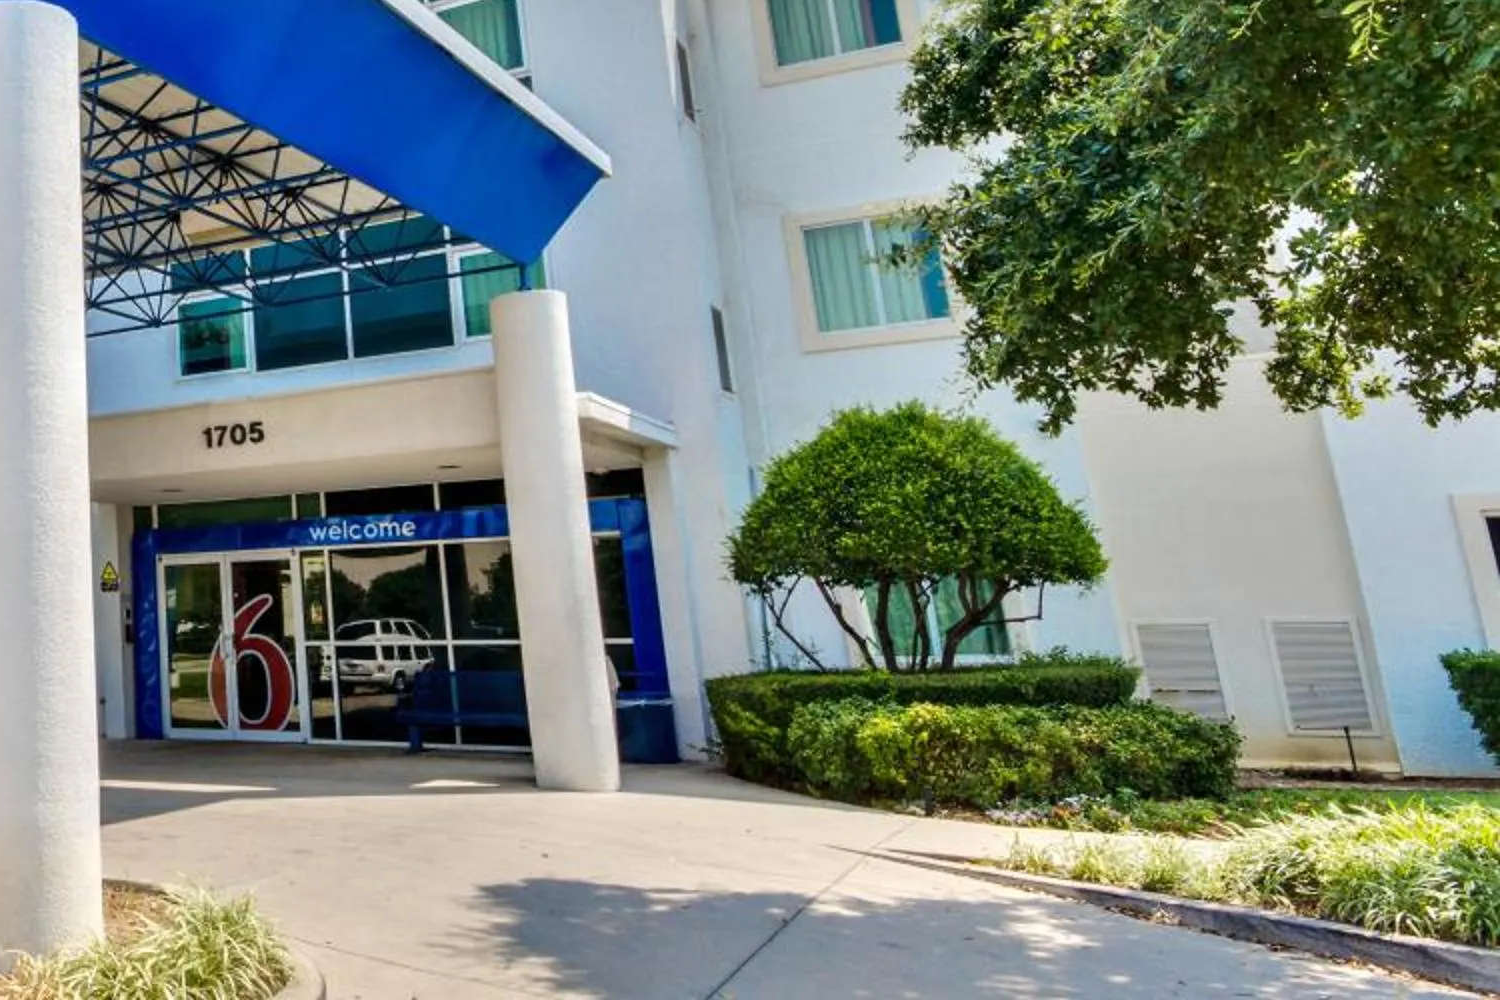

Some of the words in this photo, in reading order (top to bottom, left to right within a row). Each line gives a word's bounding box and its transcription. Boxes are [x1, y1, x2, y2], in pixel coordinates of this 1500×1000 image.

[202, 420, 265, 449] 1705
[309, 519, 417, 541] welcome
[207, 593, 296, 732] 6
